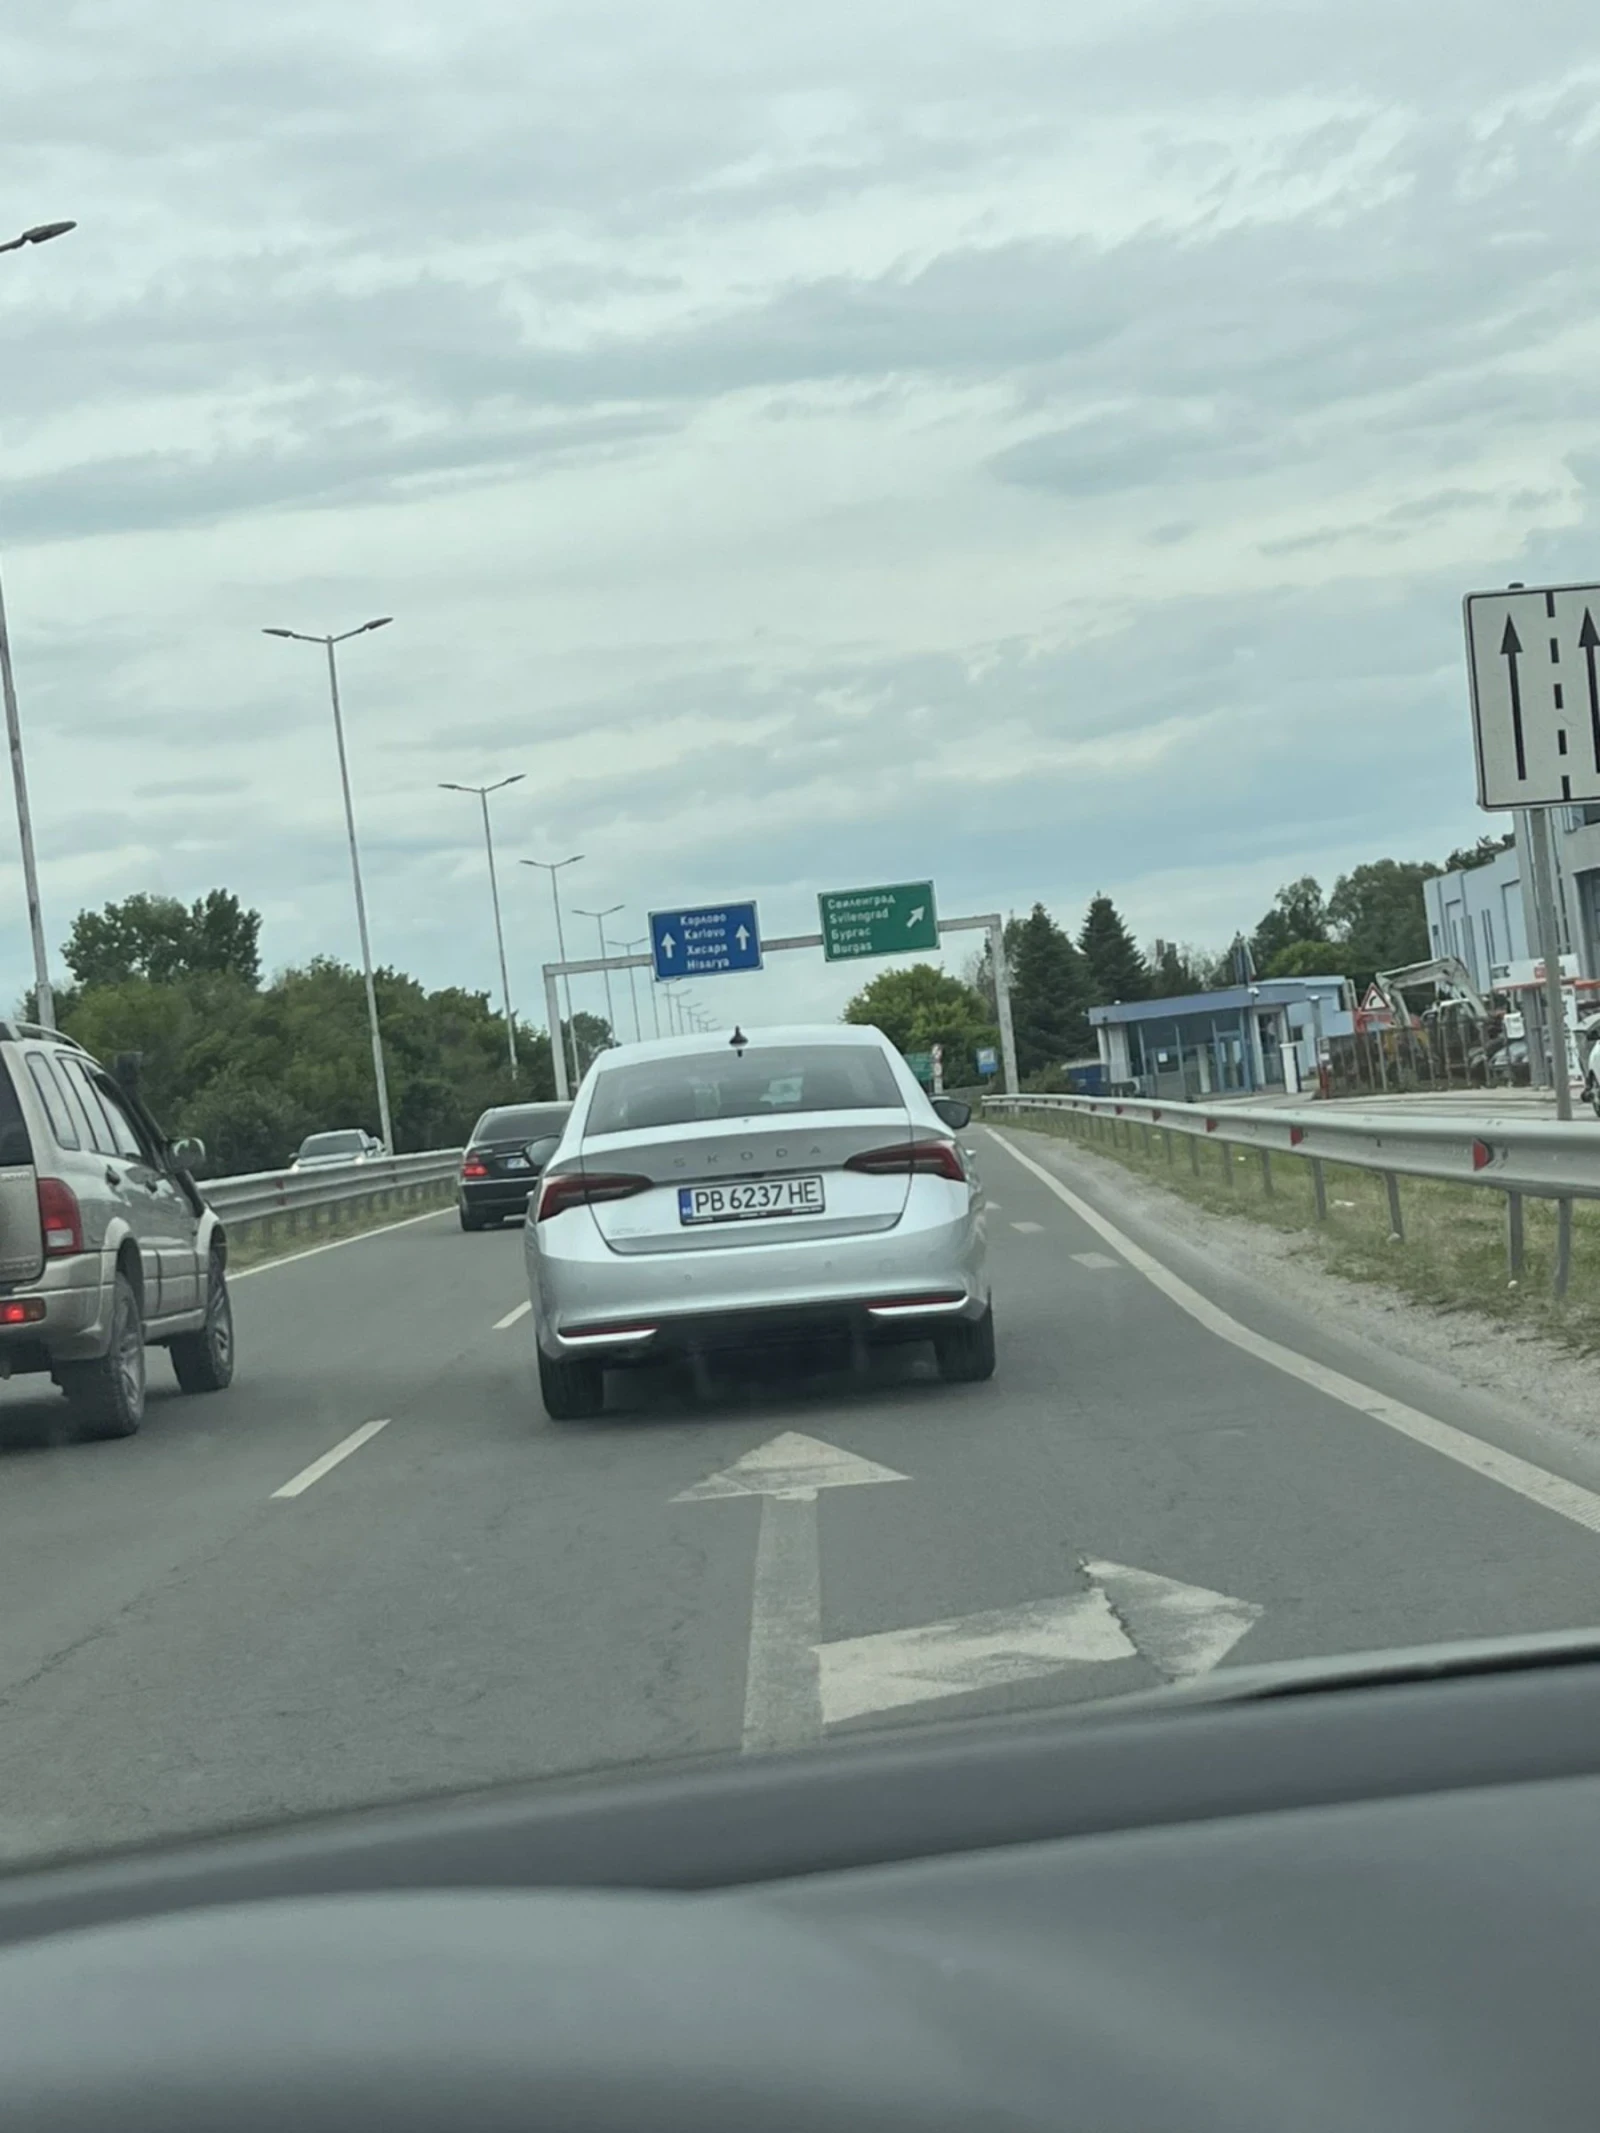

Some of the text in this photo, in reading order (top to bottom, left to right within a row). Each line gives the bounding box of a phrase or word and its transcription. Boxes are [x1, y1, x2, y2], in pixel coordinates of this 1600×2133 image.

[680, 913, 727, 927] Карлово
[829, 907, 889, 925] Svilengrad
[684, 928, 726, 940] Karlovo
[831, 927, 872, 942] Бургас
[686, 943, 728, 956] Хисаря
[832, 942, 873, 955] Burgas
[687, 957, 730, 970] Hisarya
[695, 1181, 819, 1213] PB 6237 HE
